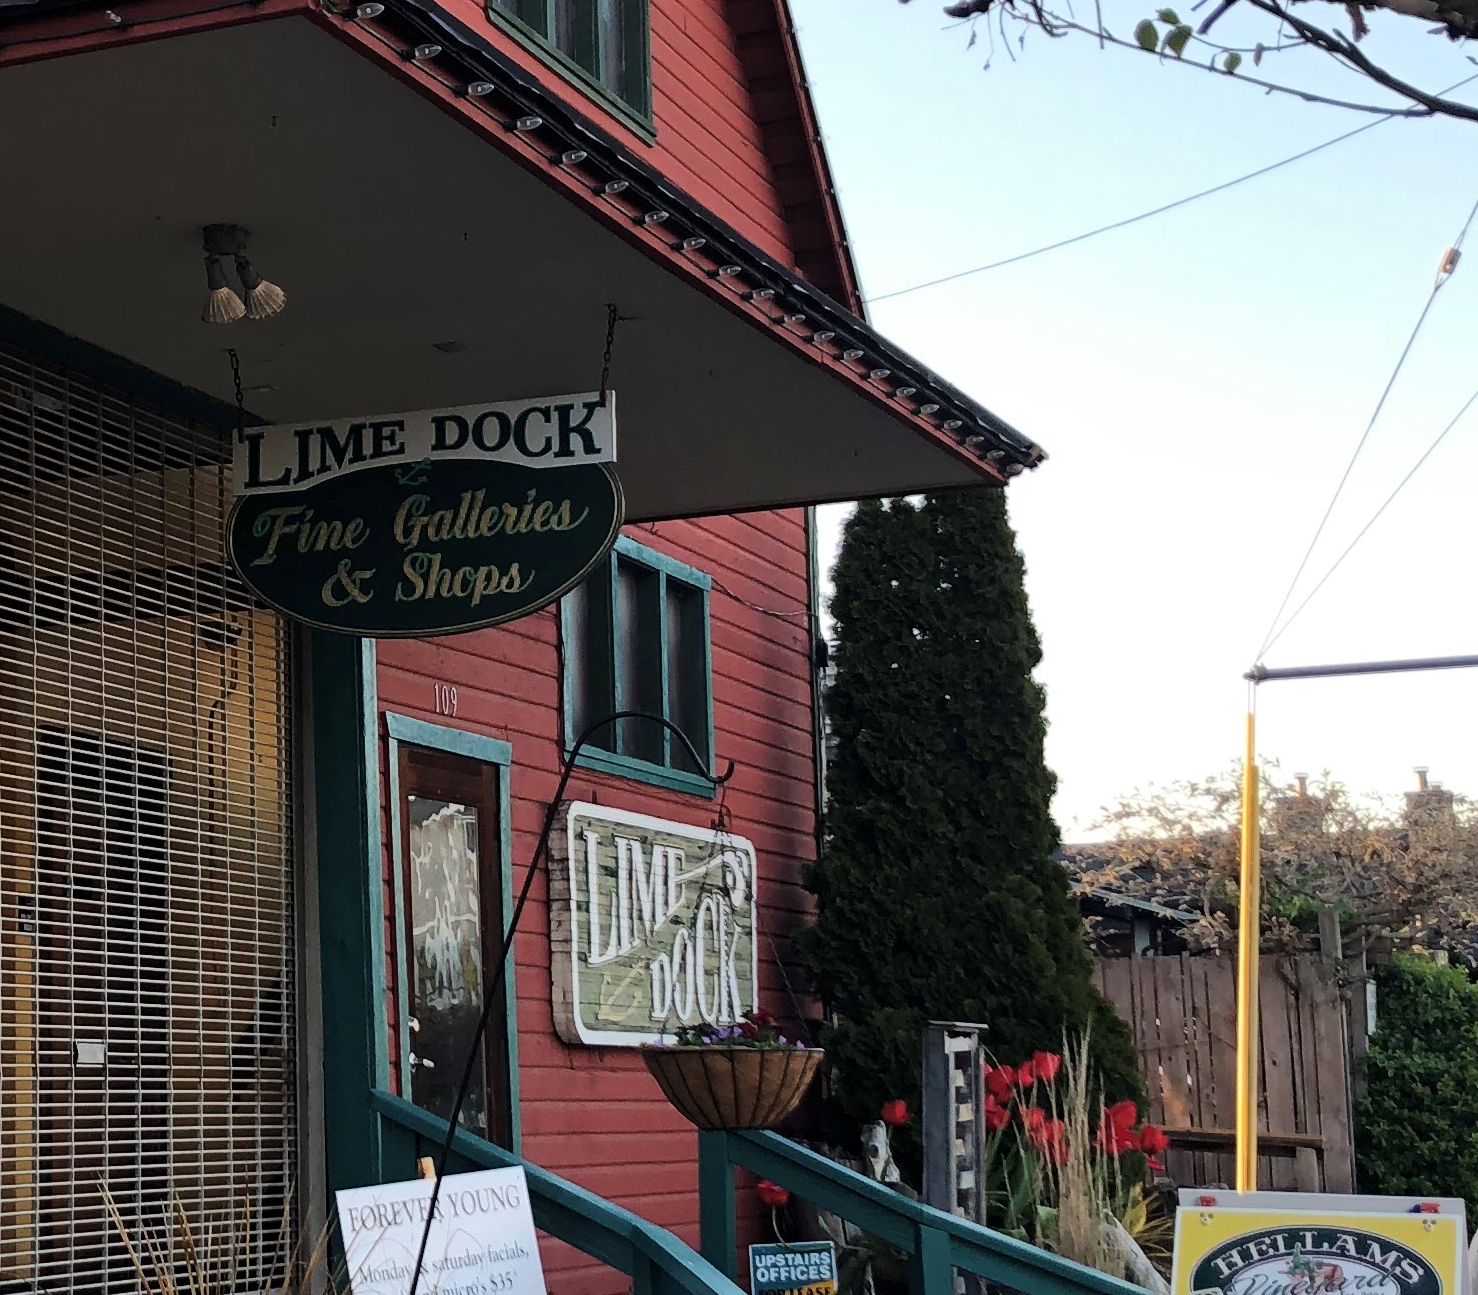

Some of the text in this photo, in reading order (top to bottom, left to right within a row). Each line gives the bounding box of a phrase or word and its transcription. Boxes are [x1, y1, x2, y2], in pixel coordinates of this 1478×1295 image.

[243, 400, 605, 490] LIME DOCK
[250, 488, 590, 567] Fine Galleries
[321, 552, 536, 608] & Shops
[433, 682, 459, 719] 109
[582, 829, 686, 967] LIME
[650, 891, 745, 1028] DOCK
[445, 1183, 521, 1219] YOUNG
[432, 1247, 485, 1274] saturday
[754, 1251, 831, 1268] UPSTAIRS
[756, 1264, 832, 1283] OFFICES
[1210, 1230, 1425, 1285] HELLAMS
